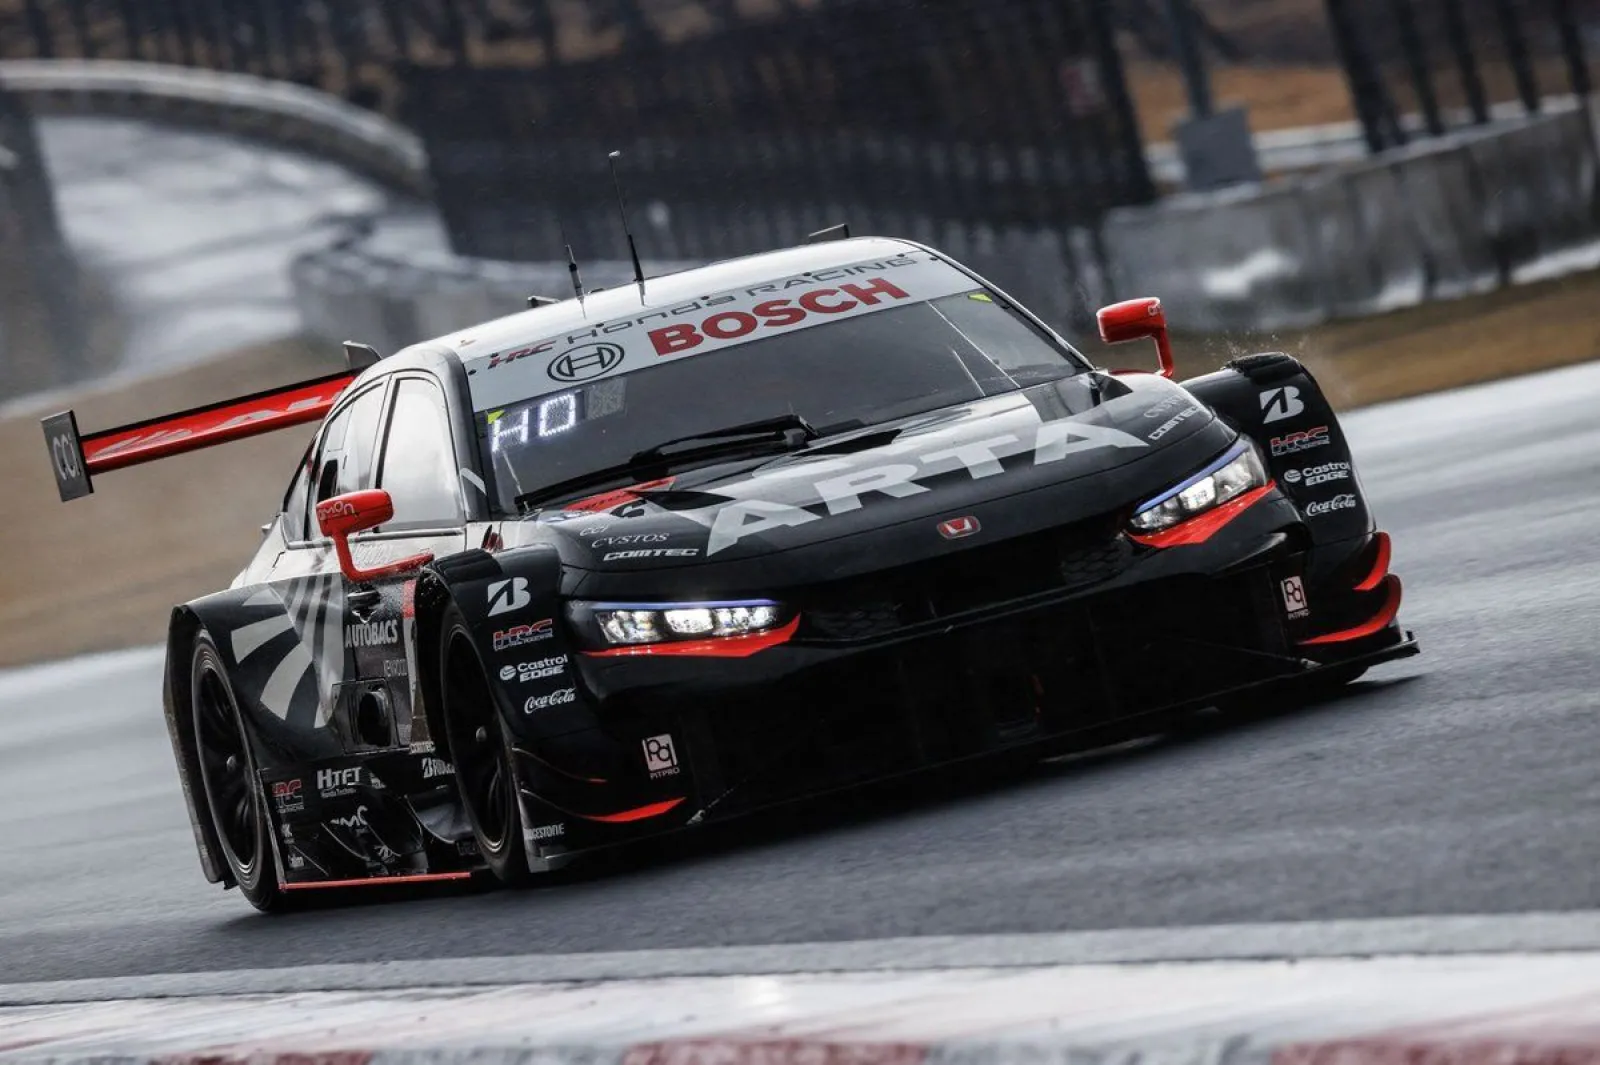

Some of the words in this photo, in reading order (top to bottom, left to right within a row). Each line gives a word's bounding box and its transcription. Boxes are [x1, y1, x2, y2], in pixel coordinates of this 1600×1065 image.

[567, 294, 737, 345] Honda
[746, 257, 918, 297] RACING
[647, 278, 910, 357] BOSCH
[706, 420, 1149, 557] ARTA
[1305, 470, 1349, 487] EDGE
[1306, 494, 1356, 517] Coca-Cola
[591, 532, 670, 549] CVSTOS
[603, 548, 699, 562] COMTEC
[345, 618, 398, 649] AUTOBACS
[493, 618, 553, 650] HRC
[517, 653, 568, 673] Castrol
[520, 664, 564, 683] EDGE
[524, 686, 576, 715] Coca-Cola
